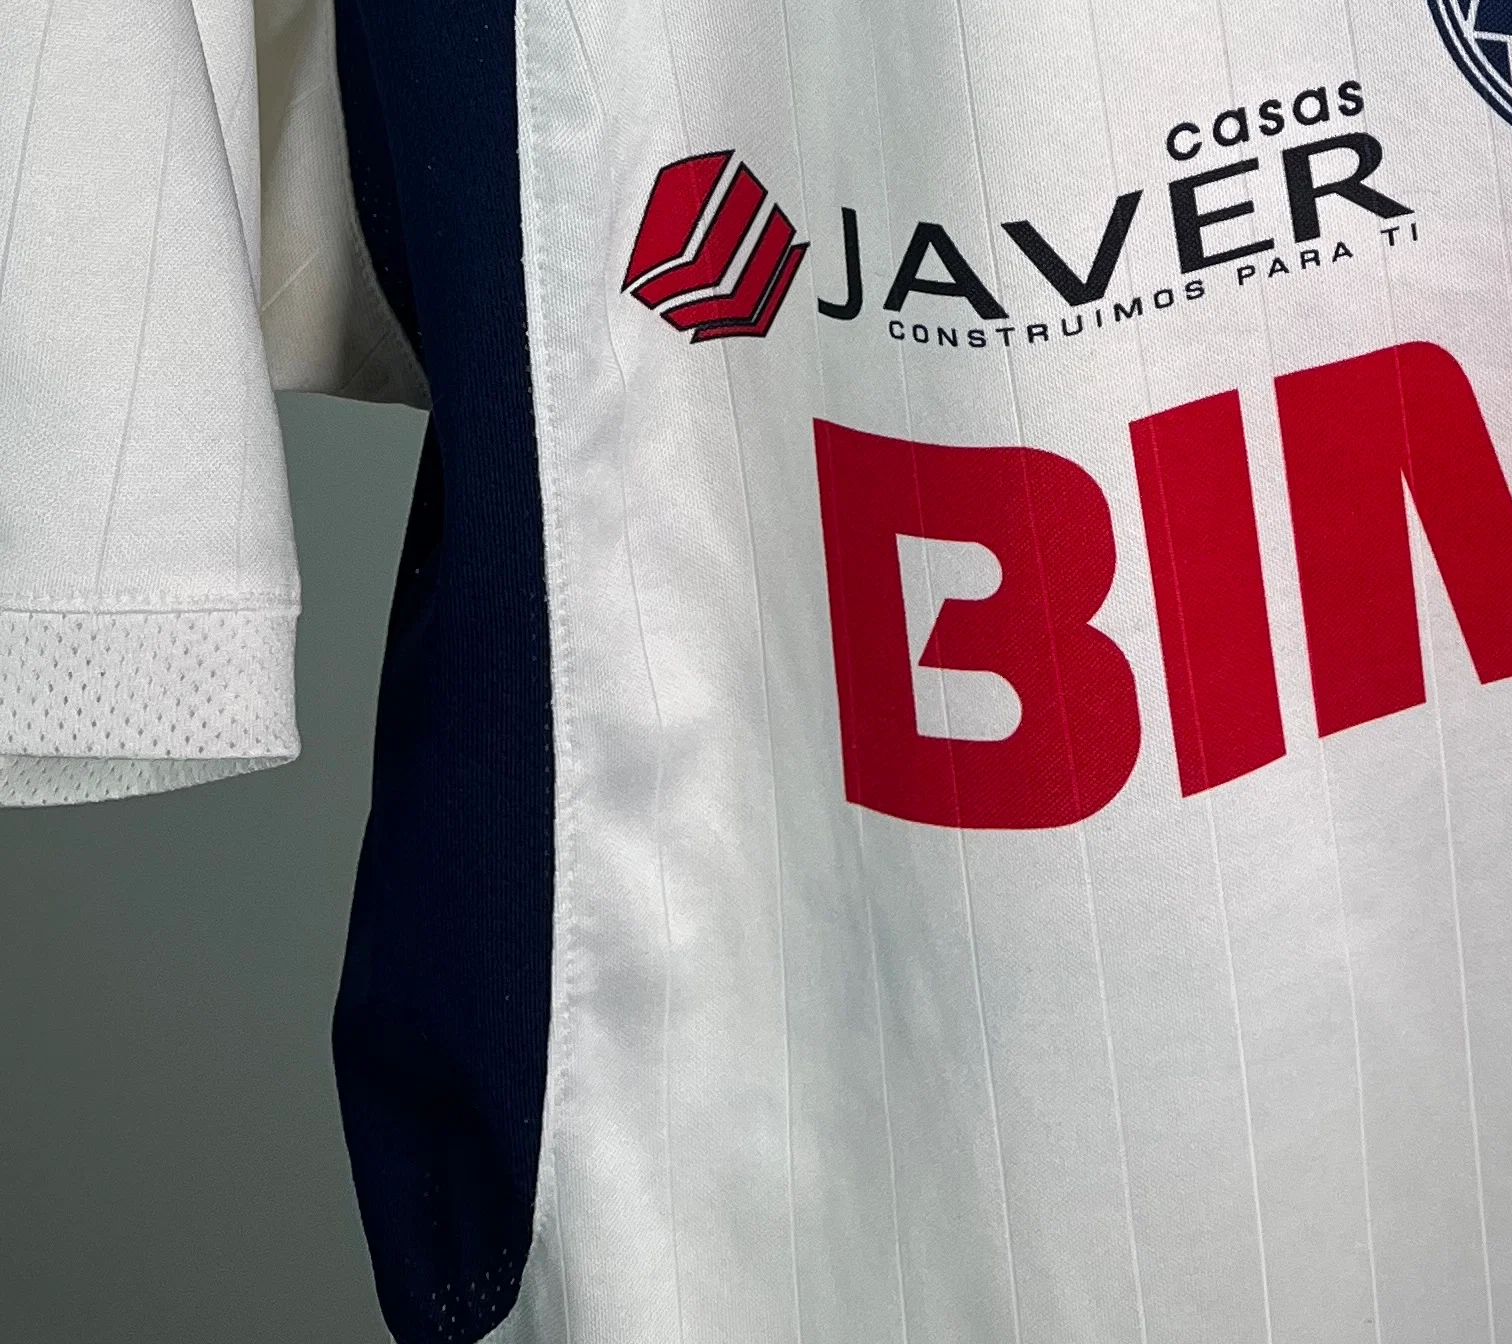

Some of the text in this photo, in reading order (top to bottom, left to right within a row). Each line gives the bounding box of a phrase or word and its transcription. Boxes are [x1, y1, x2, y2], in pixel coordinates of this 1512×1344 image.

[1165, 79, 1366, 162] casas
[816, 132, 1416, 322] JAVER
[888, 222, 1420, 350] CONSTRUIMOS PARA TI
